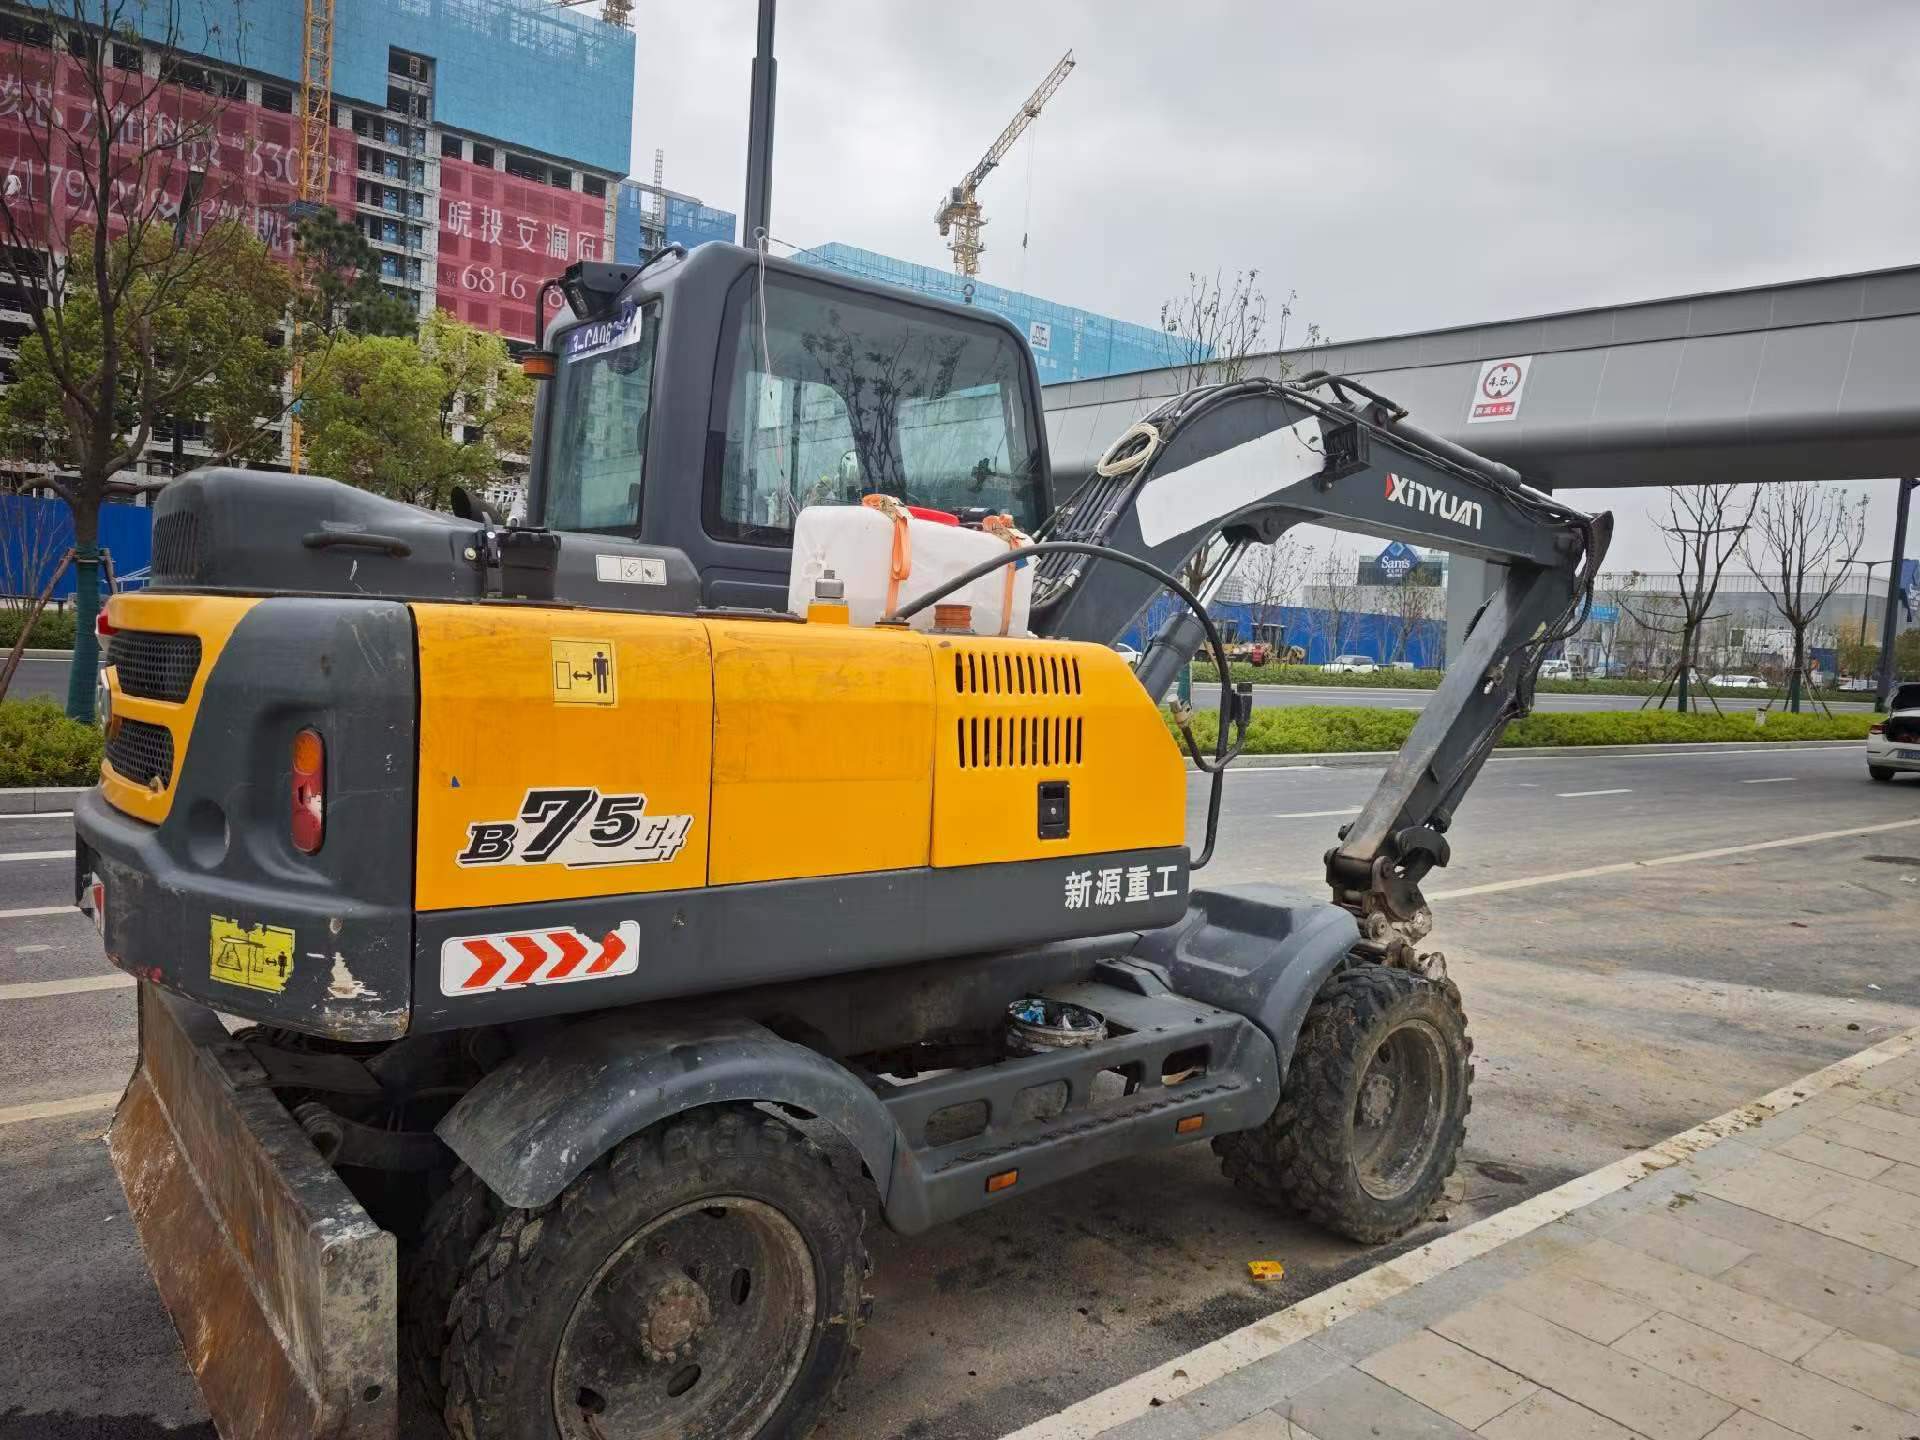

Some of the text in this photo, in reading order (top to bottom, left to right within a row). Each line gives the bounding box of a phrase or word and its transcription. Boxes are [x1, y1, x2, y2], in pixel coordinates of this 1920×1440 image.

[462, 264, 526, 300] 6816
[1064, 864, 1178, 909] 新源重工
